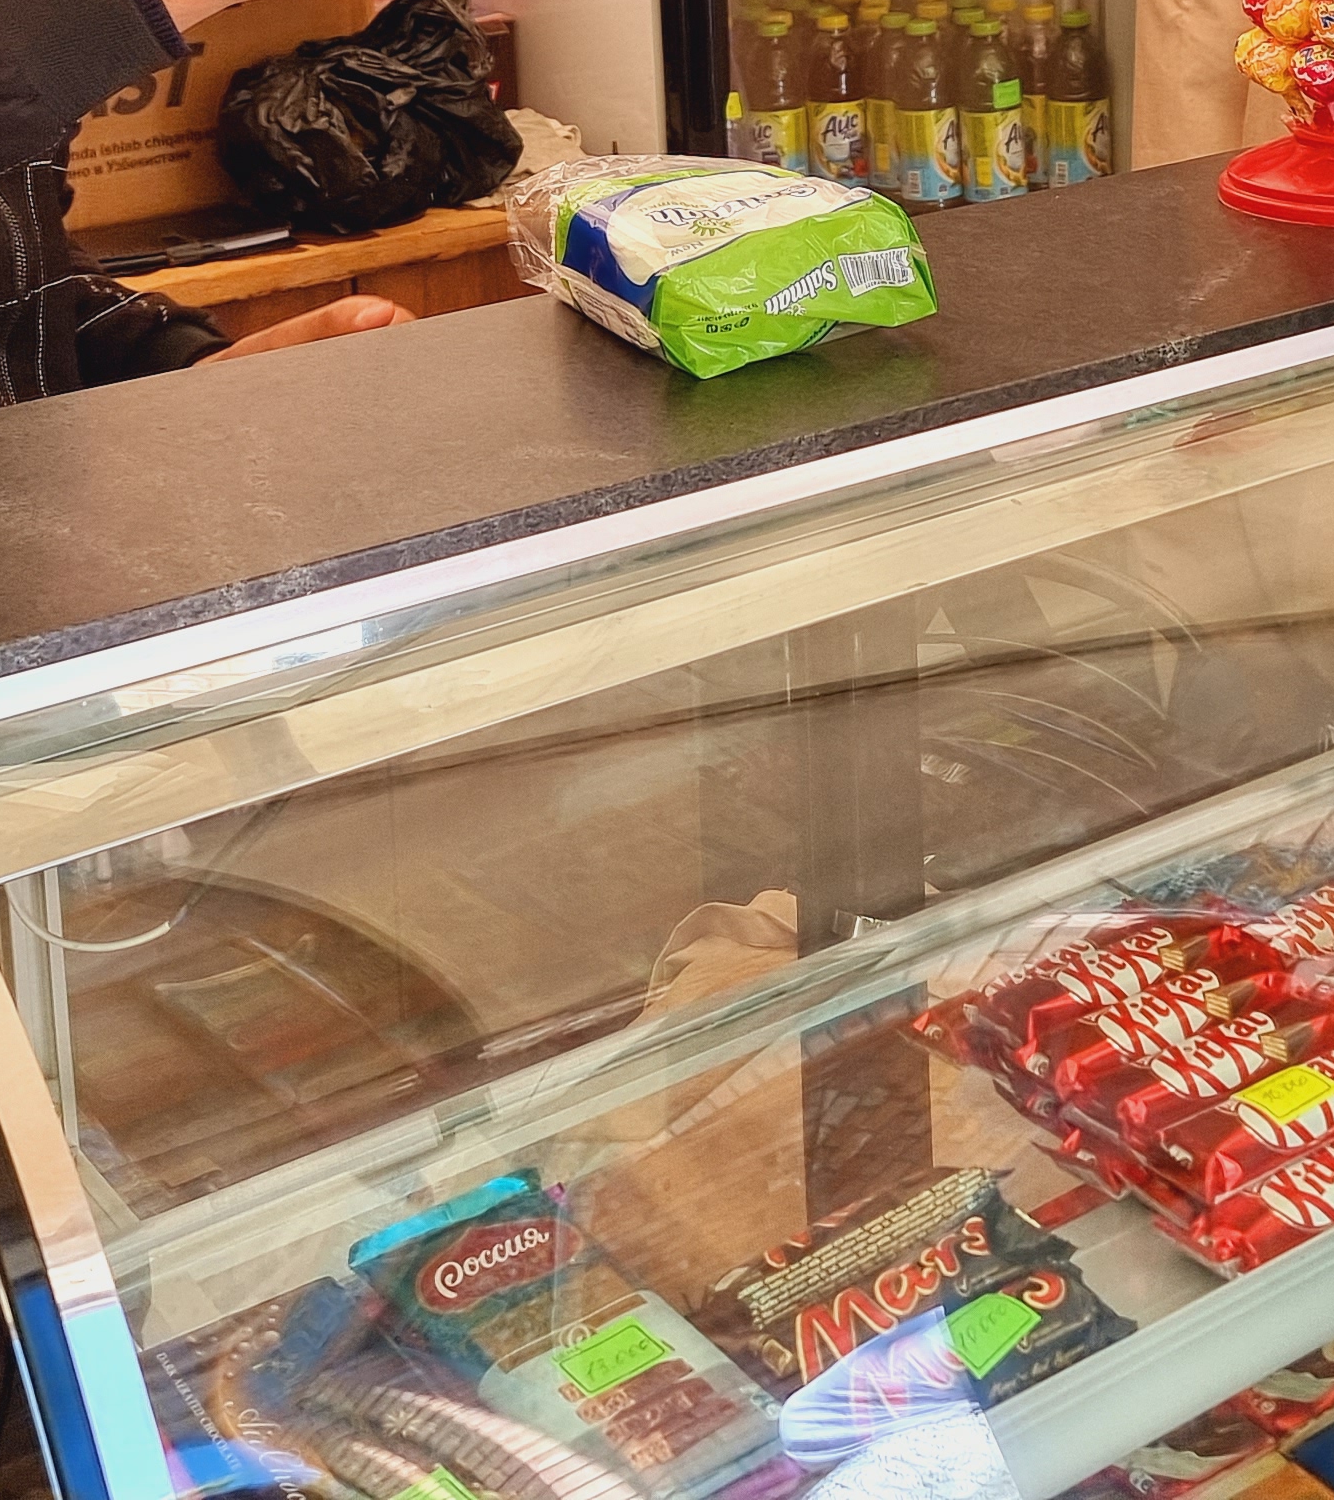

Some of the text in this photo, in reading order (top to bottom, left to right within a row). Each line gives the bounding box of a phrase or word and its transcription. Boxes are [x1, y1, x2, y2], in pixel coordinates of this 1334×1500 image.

[1057, 927, 1174, 1016] KitKat
[1098, 969, 1220, 1059] KitKat
[1151, 1012, 1275, 1099] KitKat
[434, 1227, 550, 1299] Россия
[796, 1216, 991, 1386] Mars
